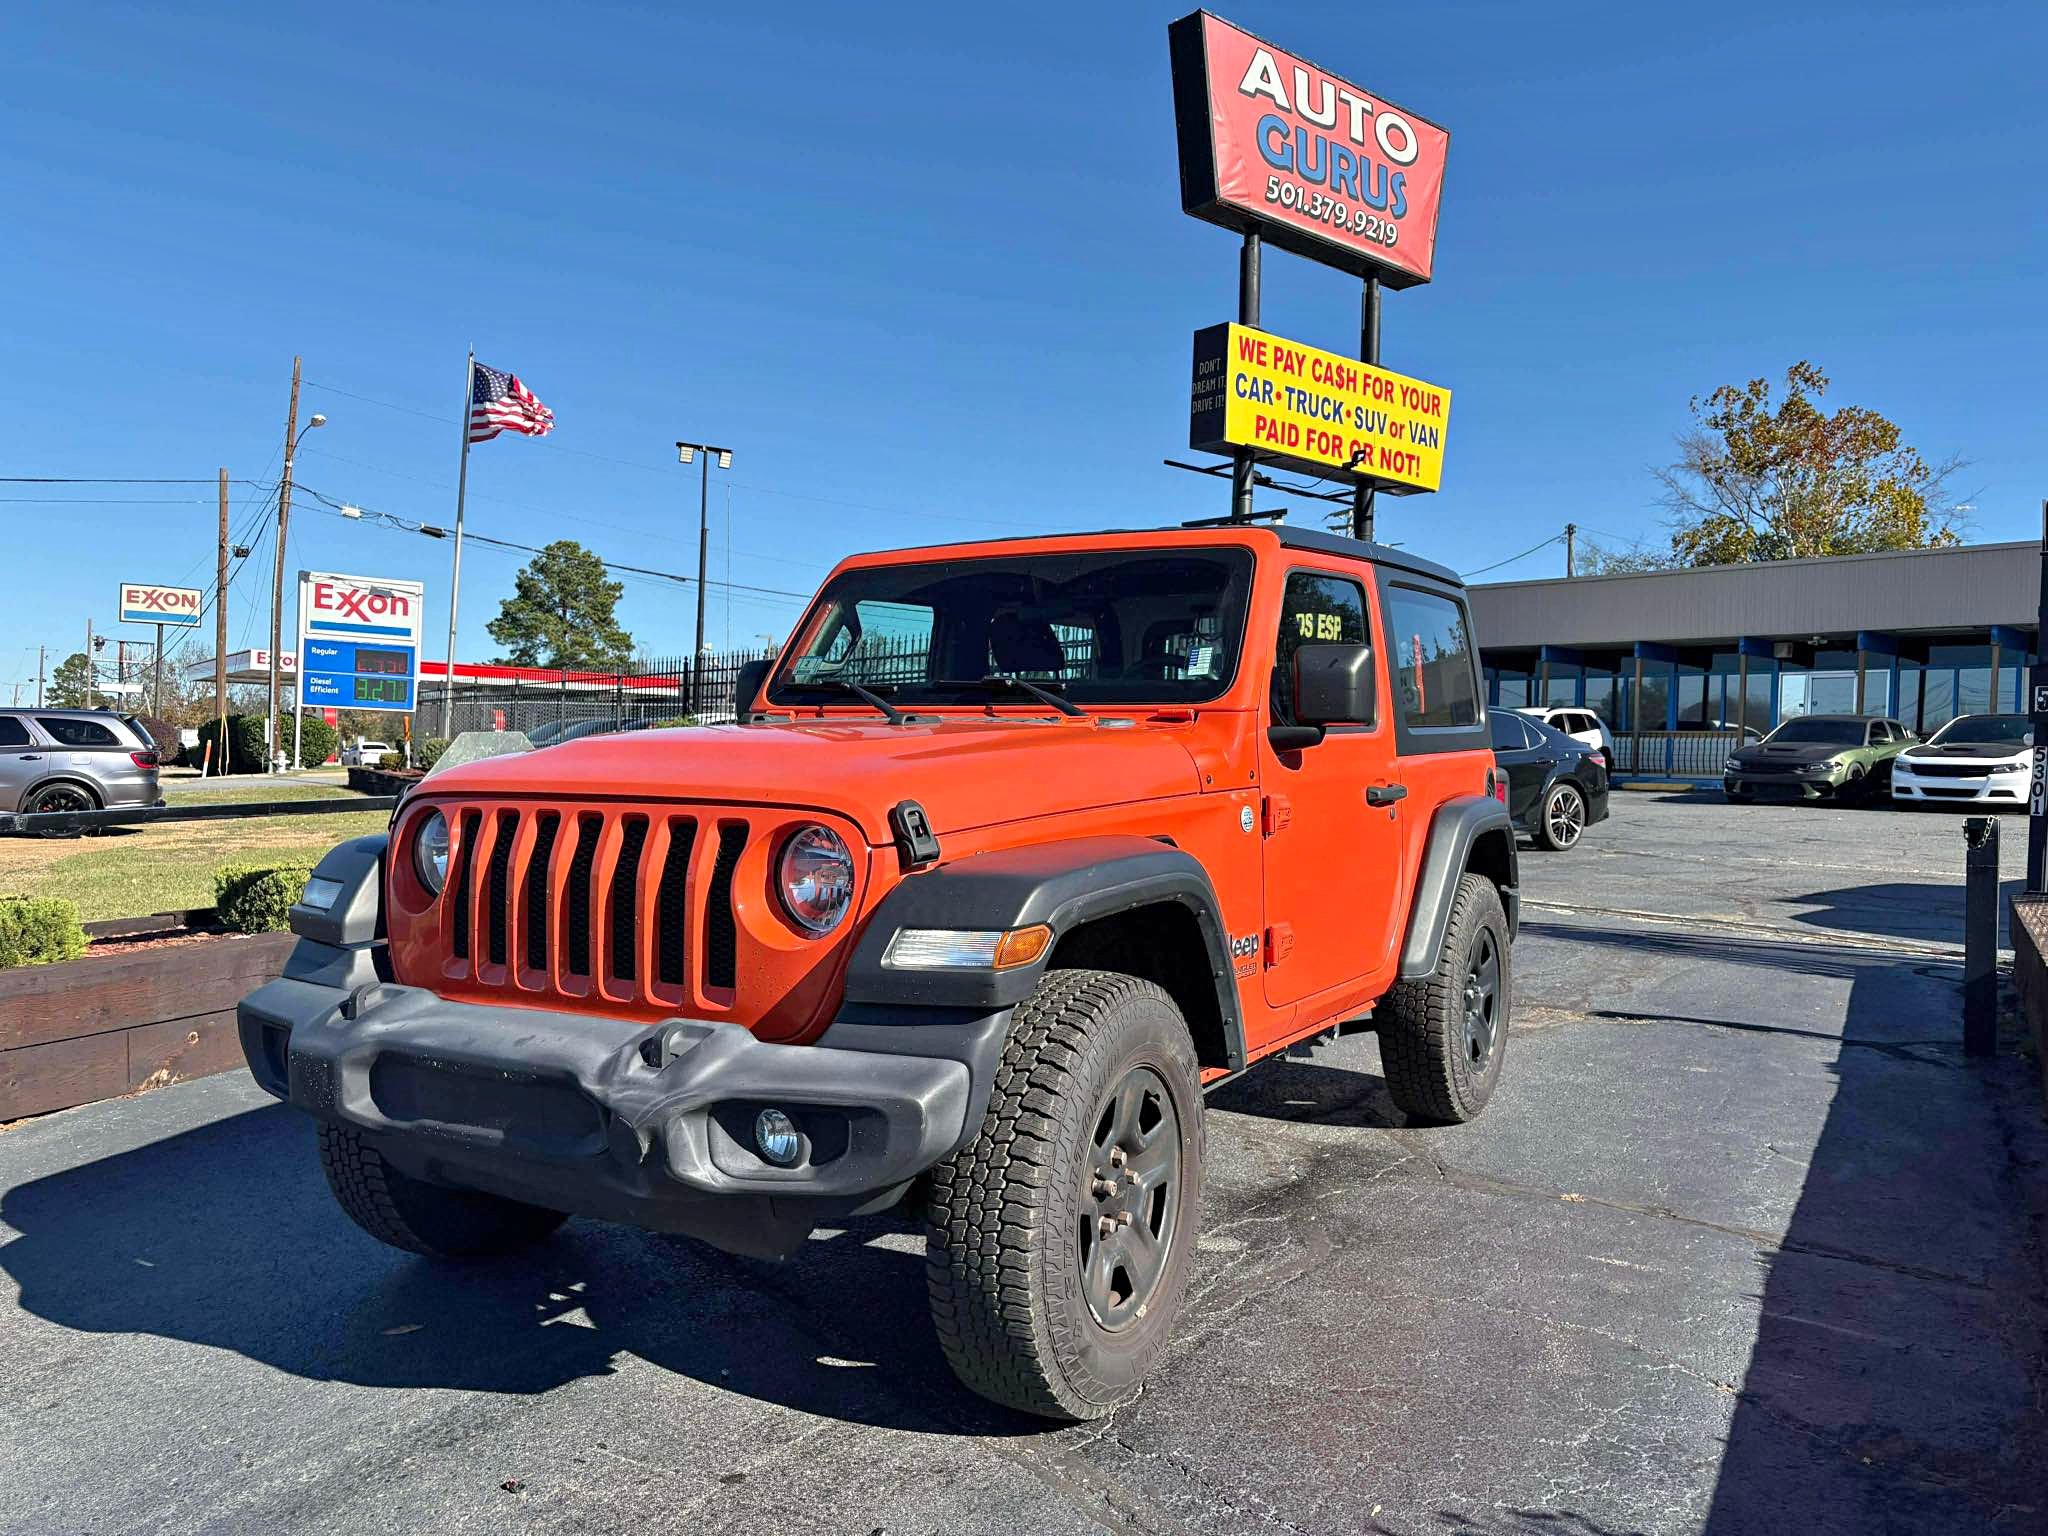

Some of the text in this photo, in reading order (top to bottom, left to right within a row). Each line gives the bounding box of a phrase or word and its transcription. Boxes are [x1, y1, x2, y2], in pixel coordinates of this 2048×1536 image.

[1238, 47, 1418, 166] AUTO
[1256, 114, 1408, 219] GURUS
[1265, 175, 1398, 247] 501.379.9219
[1199, 358, 1221, 375] DON'T
[1239, 335, 1440, 417] WE PAY CA$H FOR YOUR
[1192, 379, 1216, 396] DREAM
[1192, 397, 1213, 415] DRIVE
[1235, 373, 1438, 449] CAR TRUCK SUV or VAN
[1255, 415, 1421, 478] PAID FOR OR NOT!
[126, 589, 196, 611] EXXON
[314, 583, 409, 622] Exxon
[311, 647, 338, 656] Regular
[310, 677, 332, 686] Diesel
[310, 686, 339, 695] Efficient
[2033, 747, 2047, 815] 5301
